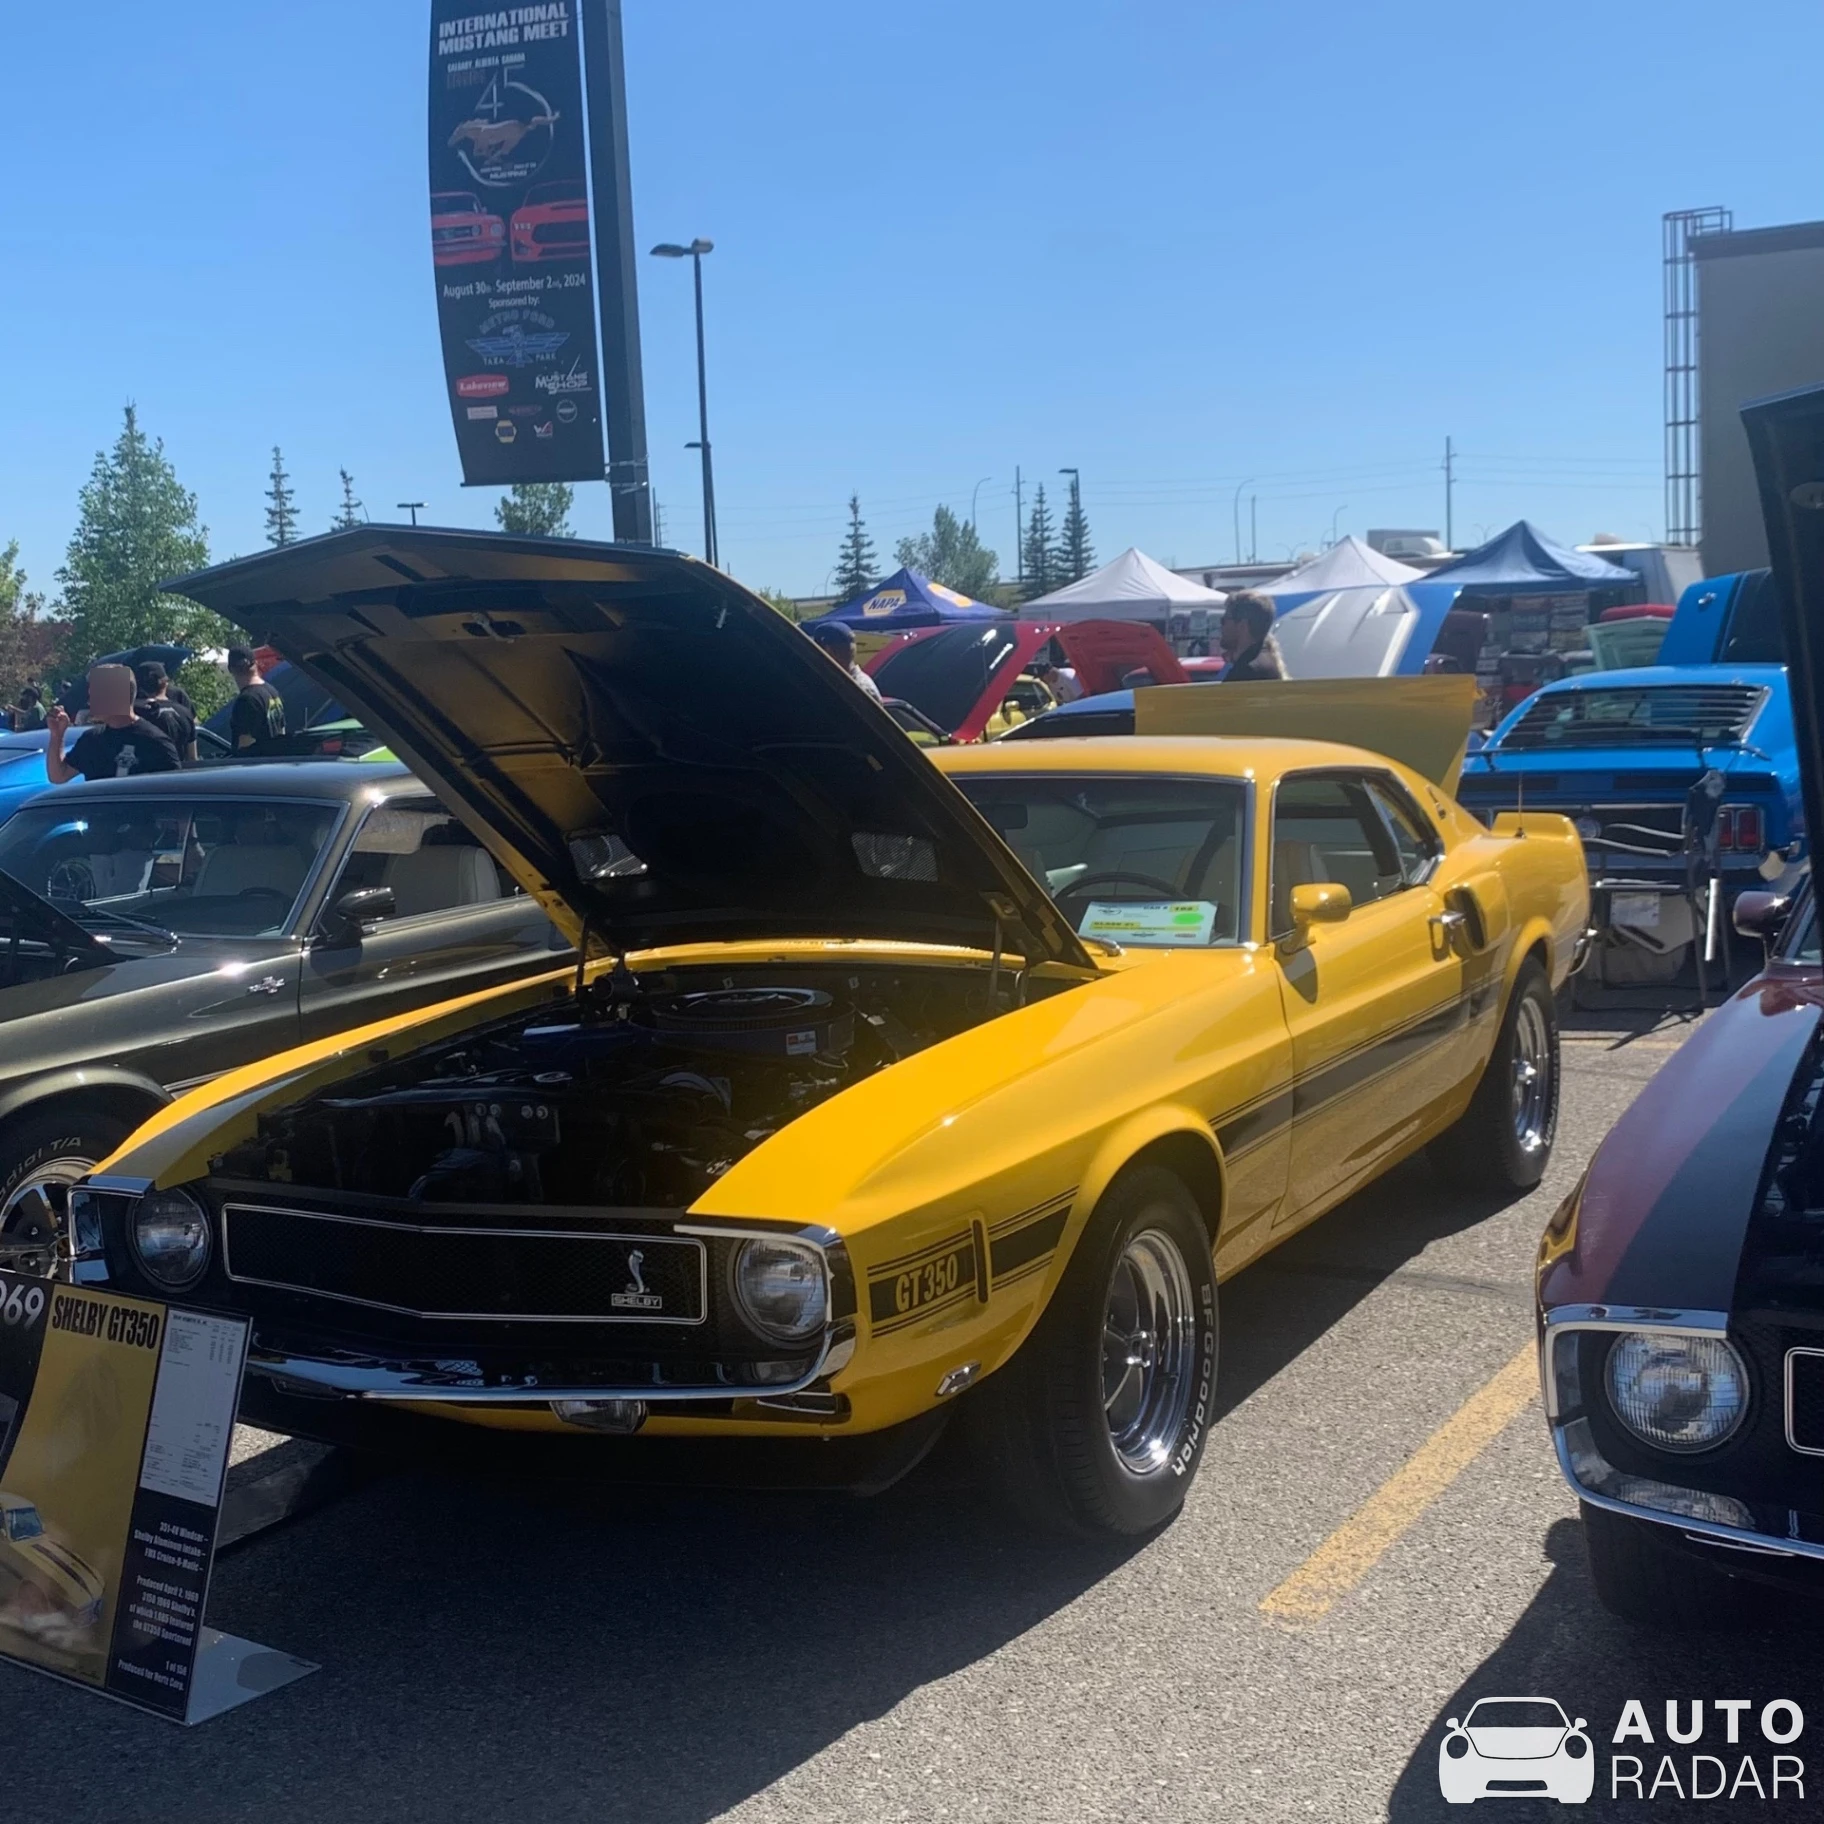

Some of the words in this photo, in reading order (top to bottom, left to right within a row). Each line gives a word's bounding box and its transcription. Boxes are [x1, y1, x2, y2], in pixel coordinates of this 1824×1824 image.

[439, 2, 568, 38] INTERNATIONAL
[438, 28, 519, 55] MUSTANG
[523, 20, 569, 42] MEET
[443, 284, 474, 299] August
[496, 277, 544, 294] September
[563, 273, 586, 287] 2024
[488, 296, 527, 309] Sponsored
[868, 597, 901, 610] NAPA
[50, 1136, 81, 1151] T/A
[614, 1295, 659, 1307] SHELBY
[52, 1294, 107, 1338] SHELBY
[107, 1305, 159, 1349] GT350
[137, 1575, 164, 1592] Produced
[118, 1659, 148, 1677] Produced
